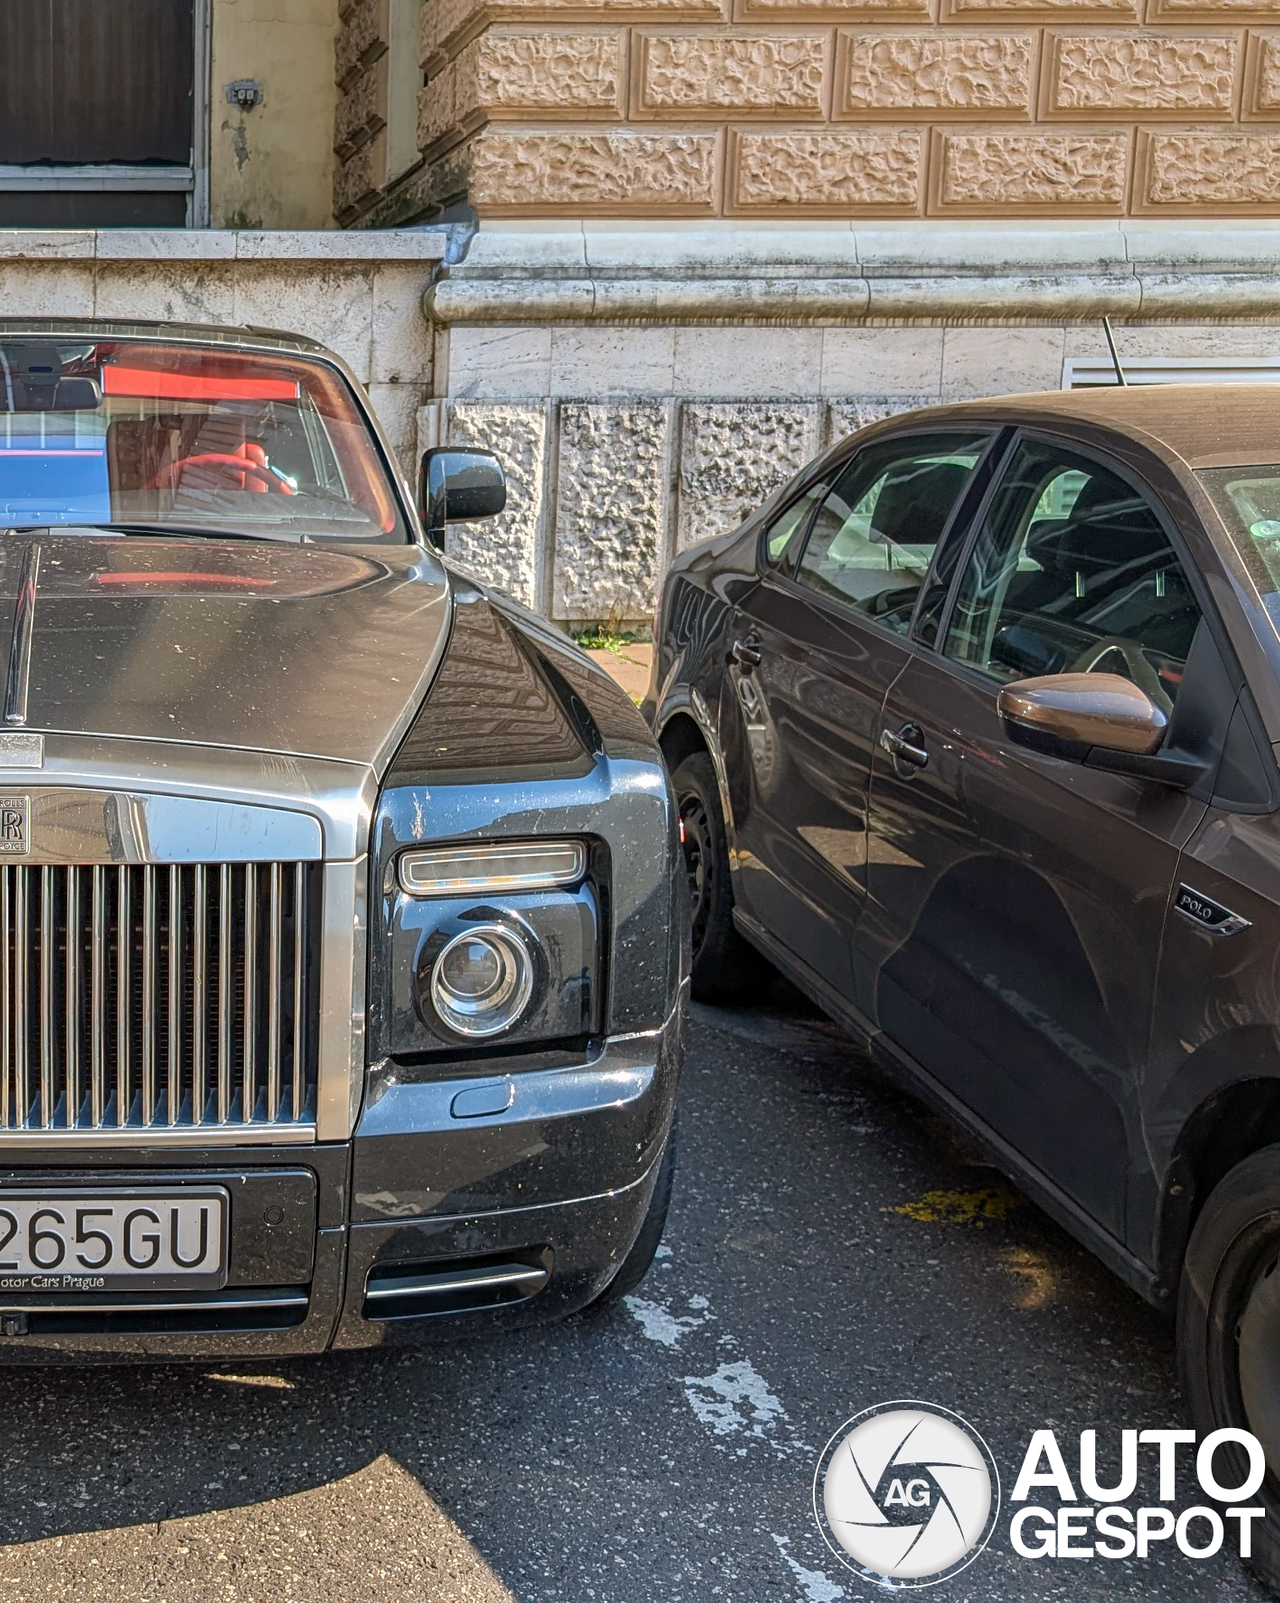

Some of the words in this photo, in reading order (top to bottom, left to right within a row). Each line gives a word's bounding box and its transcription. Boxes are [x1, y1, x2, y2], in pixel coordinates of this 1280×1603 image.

[1, 810, 23, 839] RR
[0, 842, 24, 850] ROYCE
[1180, 894, 1212, 919] POLO
[31, 1276, 59, 1287] Cars
[62, 1275, 105, 1290] Prague
